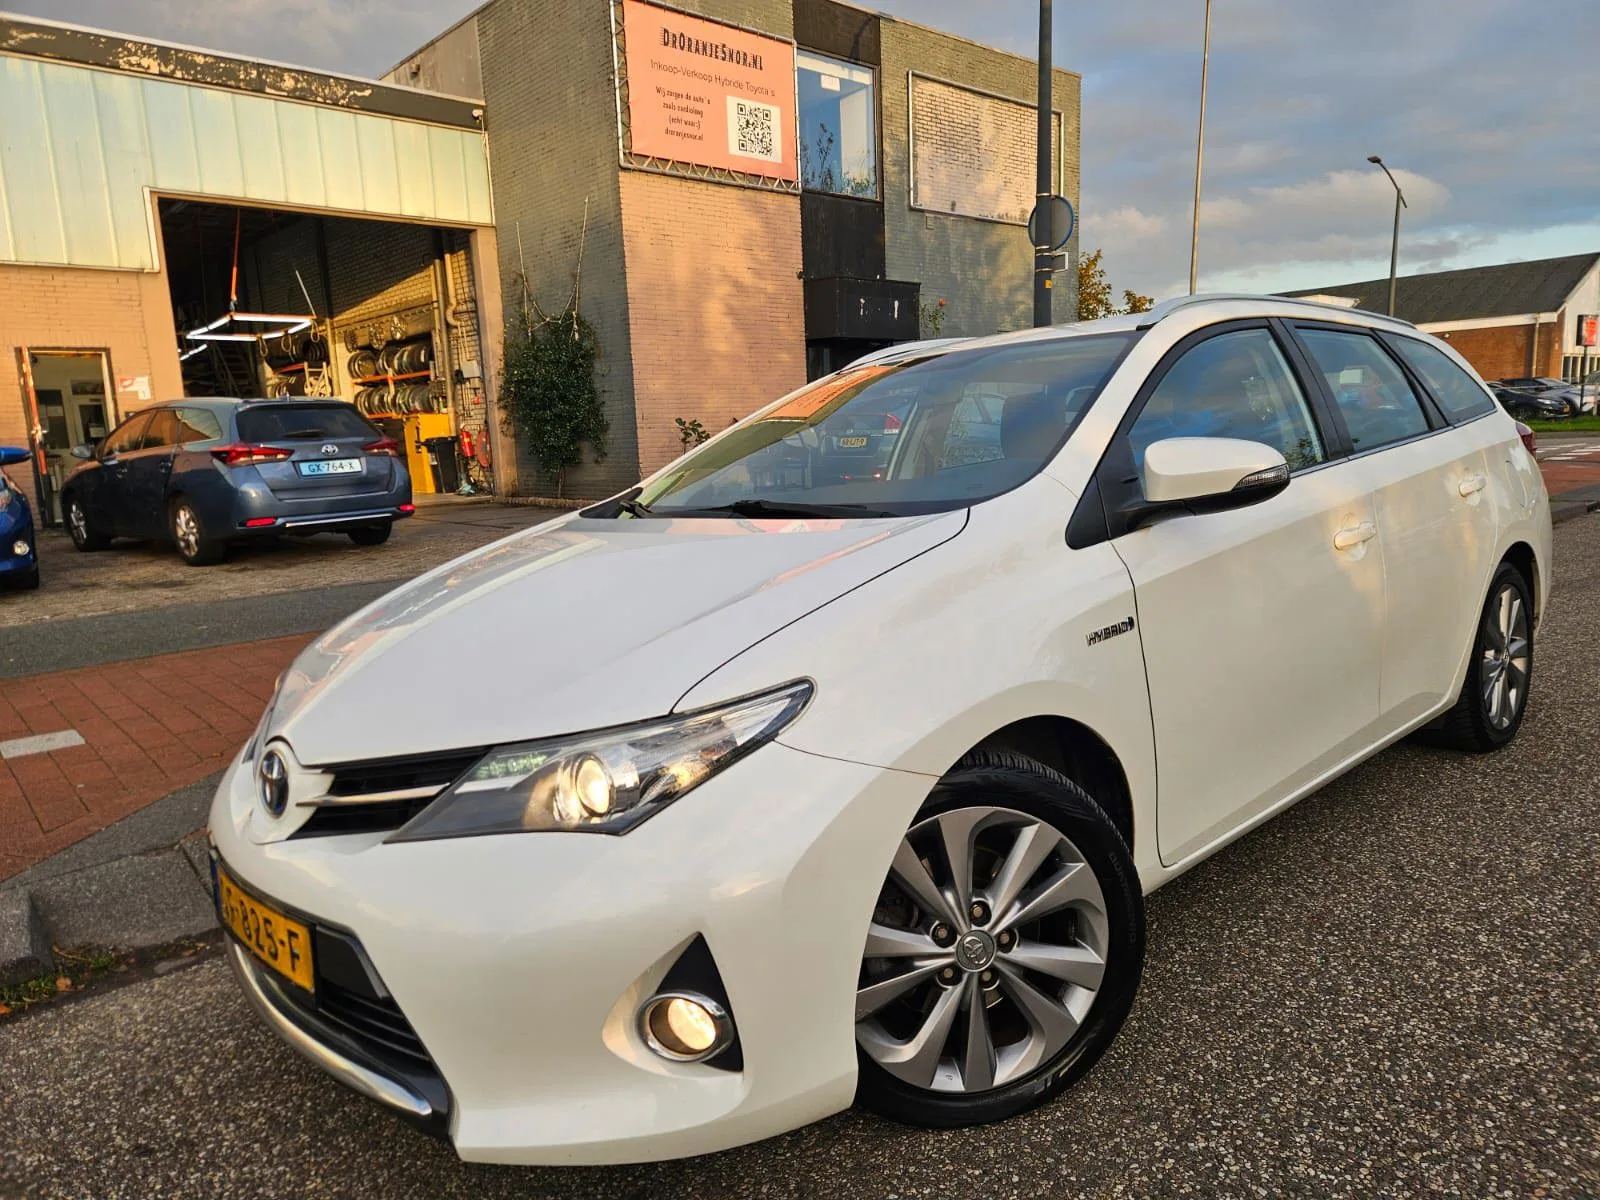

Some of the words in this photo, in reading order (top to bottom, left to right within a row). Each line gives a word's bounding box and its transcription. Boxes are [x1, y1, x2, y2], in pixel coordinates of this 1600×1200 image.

[650, 59, 713, 83] Inkoop-Verkoop
[714, 74, 744, 90] Hybride
[655, 85, 666, 97] Wij
[307, 462, 356, 473] GX-764-X
[1085, 616, 1135, 647] HYBRID
